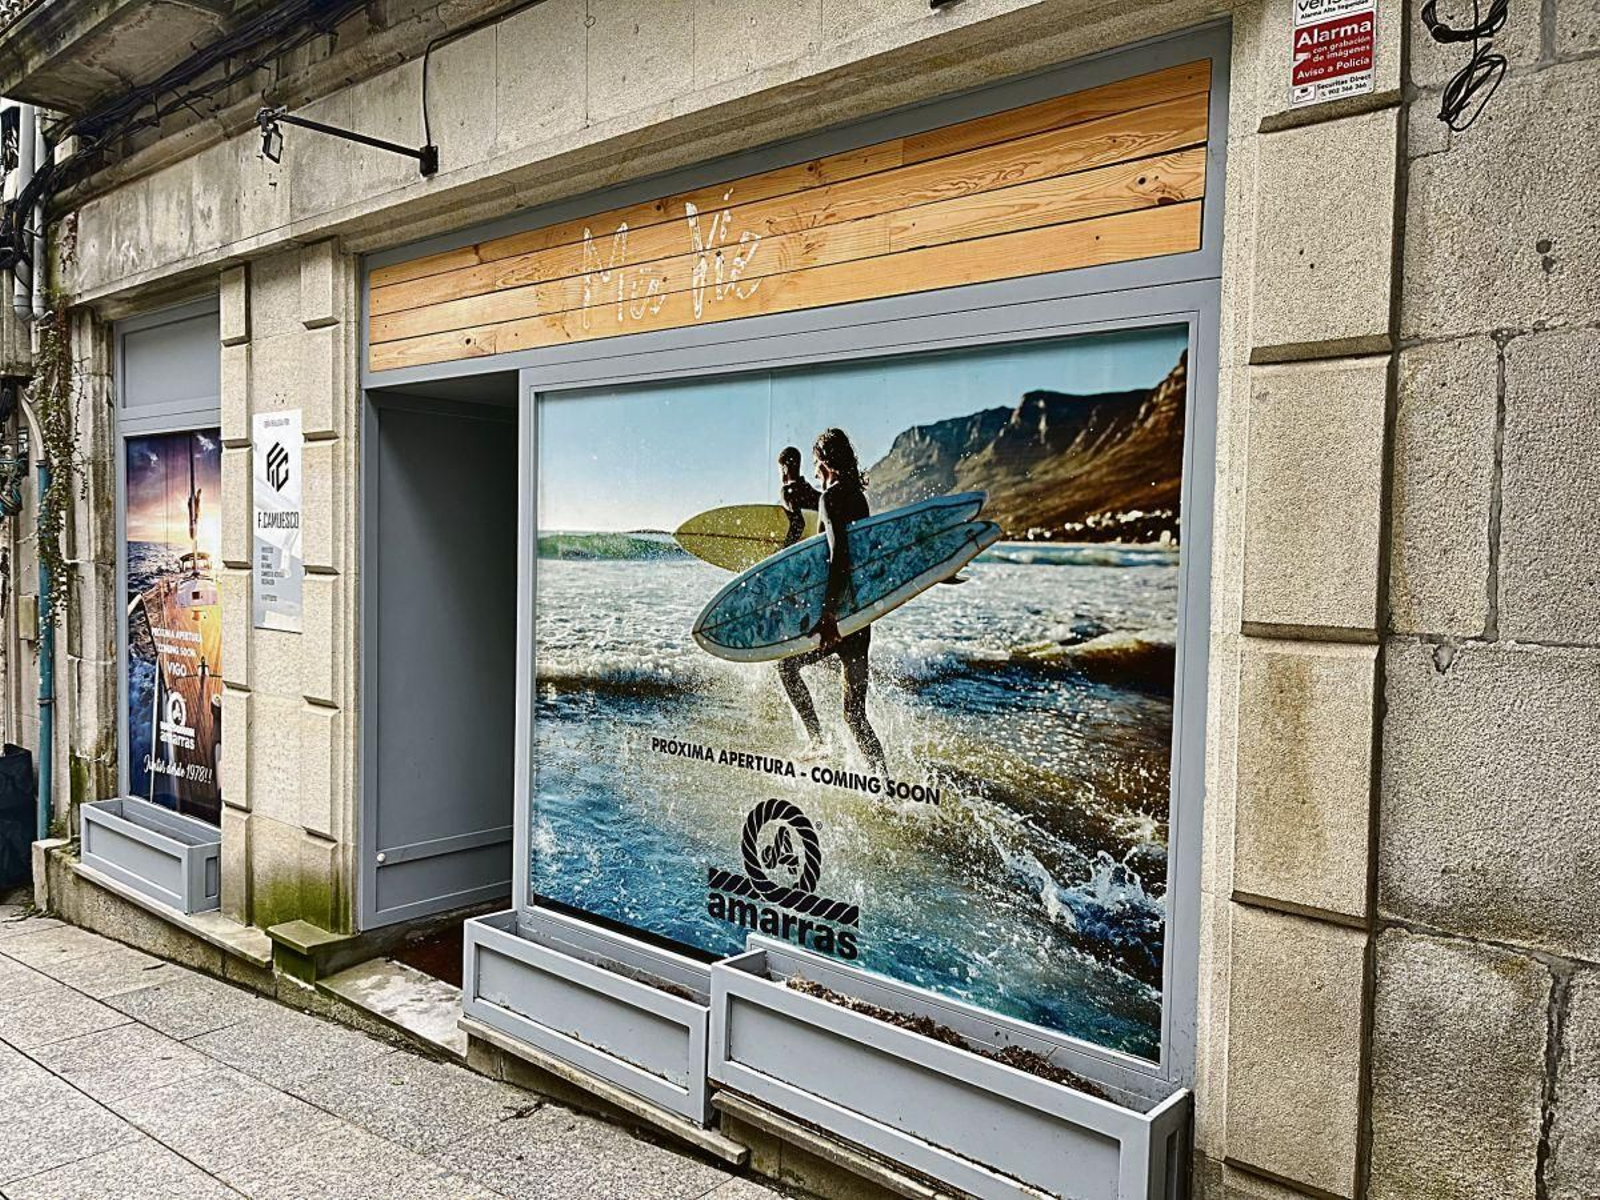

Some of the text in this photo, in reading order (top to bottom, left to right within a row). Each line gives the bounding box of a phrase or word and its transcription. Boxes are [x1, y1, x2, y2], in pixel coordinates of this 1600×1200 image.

[1300, 10, 1322, 19] Alarma
[1323, 6, 1336, 14] Alta
[1296, 20, 1372, 48] Alarma
[1312, 36, 1371, 54] con grabación
[1312, 45, 1370, 62] de imágenes
[1296, 67, 1325, 79] Aviso
[1336, 56, 1370, 70] Policía
[1316, 74, 1372, 90] Securitas Direct
[167, 661, 187, 677] VIGO
[186, 763, 213, 785] 1978!!
[651, 735, 715, 763] PRÓXIMA
[718, 749, 796, 778] APERTURA
[810, 765, 882, 795] COMING
[886, 779, 941, 806] SOON
[707, 891, 859, 961] amarras
